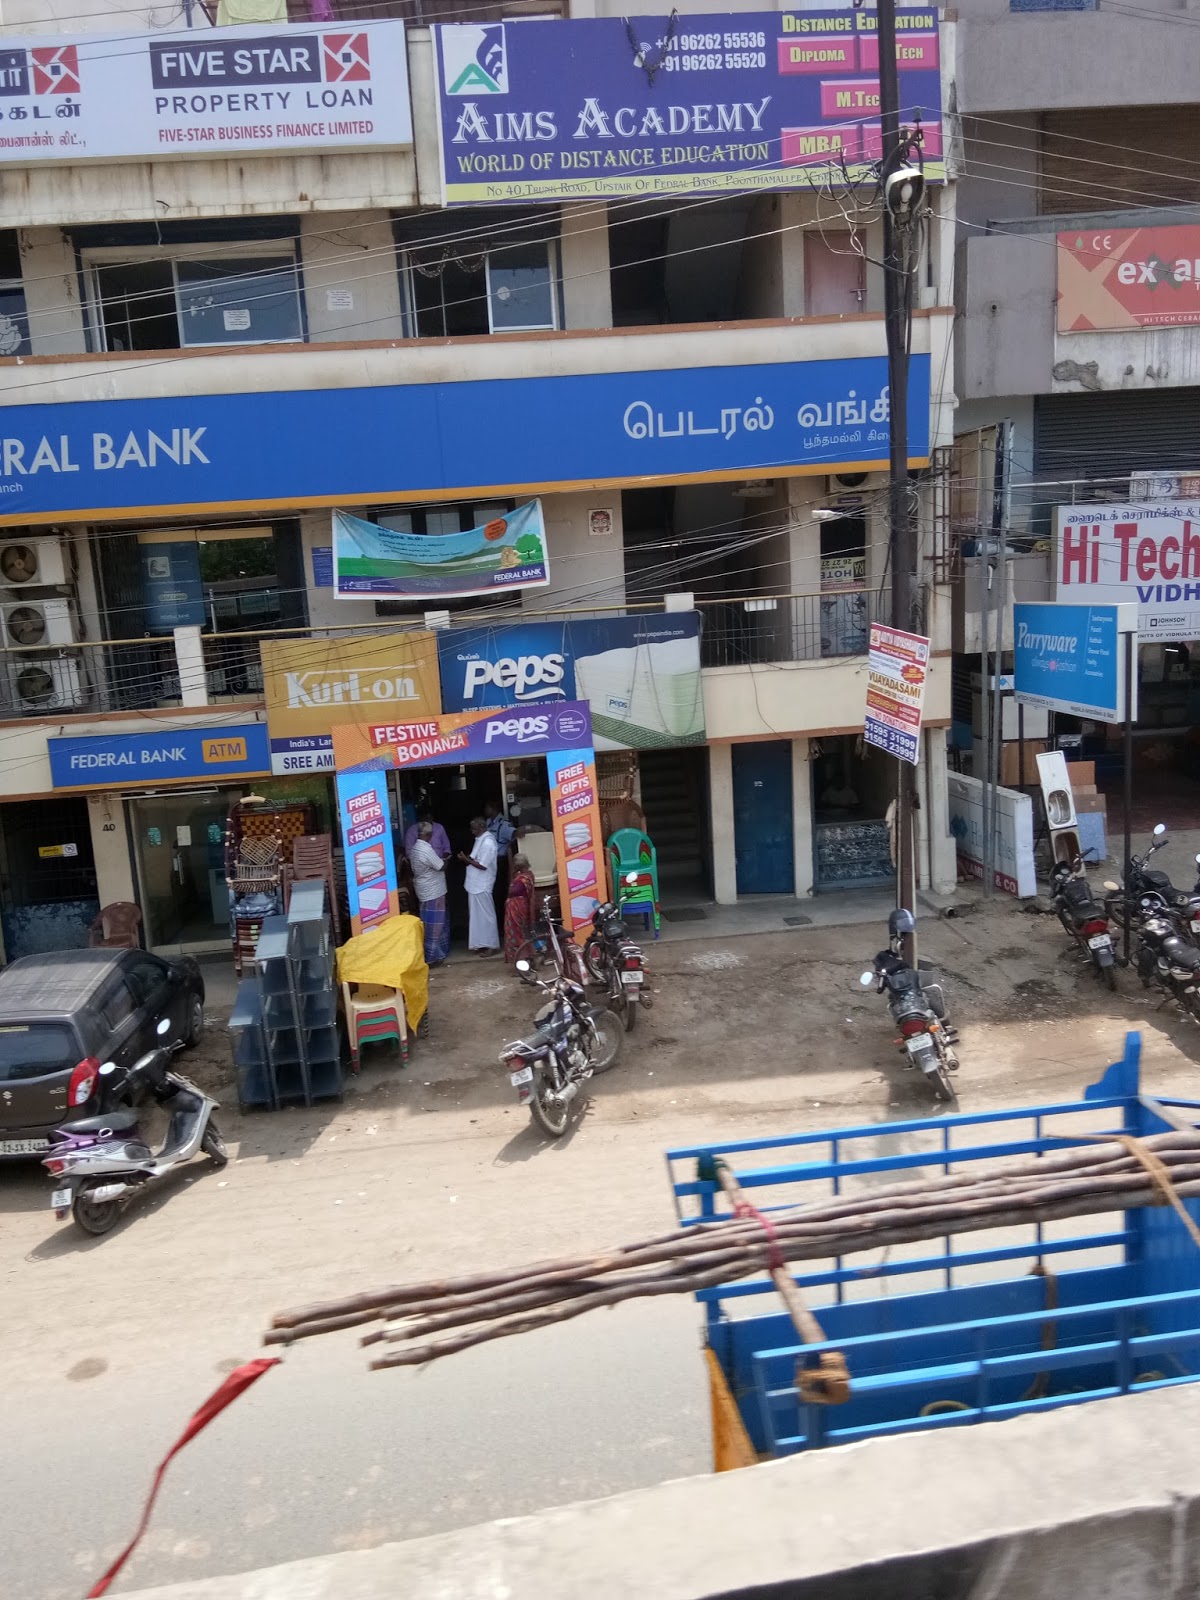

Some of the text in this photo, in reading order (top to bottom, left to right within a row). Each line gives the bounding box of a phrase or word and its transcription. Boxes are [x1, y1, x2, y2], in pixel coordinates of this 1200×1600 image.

[680, 33, 721, 49] 96262
[724, 32, 765, 48] 55536
[160, 48, 312, 77] FIVE STAR
[682, 54, 722, 70] 96262
[725, 52, 766, 69] 55520
[155, 88, 373, 114] PROPERTY LOAN
[158, 120, 373, 143] FIVE-STAR BUSINESS FINANCE LIMITED
[800, 136, 843, 156] MBA
[456, 143, 769, 173] WORLD OF DISTANCE EDUCATION
[623, 396, 775, 441] பெடரல்
[0, 427, 211, 476] RAL BANK
[1062, 520, 1200, 585] Hi Tech
[494, 571, 521, 581] FEDERAL
[522, 568, 542, 577] BANK
[1018, 622, 1078, 656] Parryware
[289, 739, 315, 748] India's
[374, 723, 438, 745] FESTIVE
[70, 742, 242, 769] FEDERAL BANK ATM
[397, 734, 465, 763] BONANZA
[283, 756, 313, 770] SREE
[558, 764, 583, 782] FREE
[561, 776, 590, 795] GIFTS
[348, 792, 376, 811] FREE
[352, 804, 381, 824] GIFTS
[1003, 879, 1016, 893] CO
